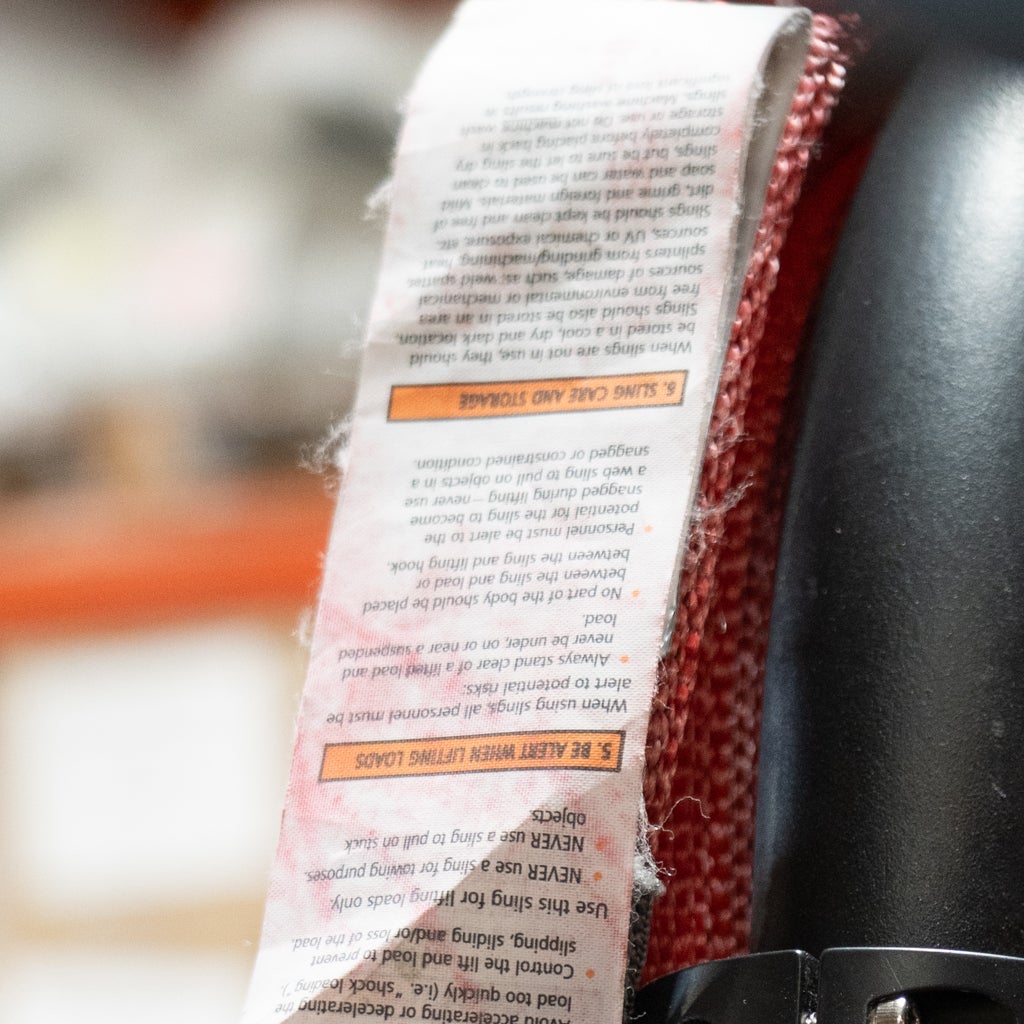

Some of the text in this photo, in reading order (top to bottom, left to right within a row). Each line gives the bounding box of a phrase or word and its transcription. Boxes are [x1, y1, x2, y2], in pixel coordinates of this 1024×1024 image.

[530, 349, 543, 359] in
[548, 348, 573, 360] not
[576, 345, 600, 357] are
[604, 341, 645, 356] slings
[651, 341, 692, 354] When
[463, 350, 493, 366] they
[531, 390, 566, 405] AND
[569, 386, 609, 403] CARE
[614, 383, 658, 400] SLING
[459, 392, 527, 410] STORAGE
[362, 585, 623, 616] No part of the body should be placed
[582, 613, 618, 628] load.
[462, 640, 478, 652] or
[482, 639, 500, 650] on
[551, 635, 570, 649] be
[572, 633, 614, 645] never
[338, 644, 412, 662] suspended
[415, 644, 425, 654] a
[428, 642, 460, 654] near
[476, 658, 511, 673] clear
[513, 655, 554, 672] stand
[558, 651, 612, 668] Always
[341, 667, 369, 682] and
[371, 665, 402, 680] load
[445, 662, 455, 673] a
[456, 660, 473, 676] of
[502, 676, 571, 696] potential
[574, 677, 590, 690] to
[594, 677, 632, 693] alert
[464, 704, 483, 719] all
[535, 699, 577, 711] using
[581, 698, 628, 714] When
[326, 713, 345, 727] be
[348, 711, 385, 724] must
[388, 702, 462, 724] personnel
[355, 742, 612, 769] 5. BE ALERT WHEN LIFTING LOADS
[344, 830, 584, 854] NEVER use a sling to pull on stuck
[304, 857, 582, 884] NEVER use a sling for towing purposes.
[331, 888, 608, 917] Use this sling for lifting loads only.
[291, 928, 576, 954] slipping, sliding and/or loss of the load.
[310, 948, 574, 978] Control the lift and load to prevent
[410, 983, 439, 999] (i.e.
[444, 983, 500, 1002] quickly
[506, 992, 531, 1007] too
[537, 994, 571, 1010] load
[275, 1003, 294, 1014] the
[299, 997, 394, 1020] decelerating
[399, 1007, 416, 1019] or
